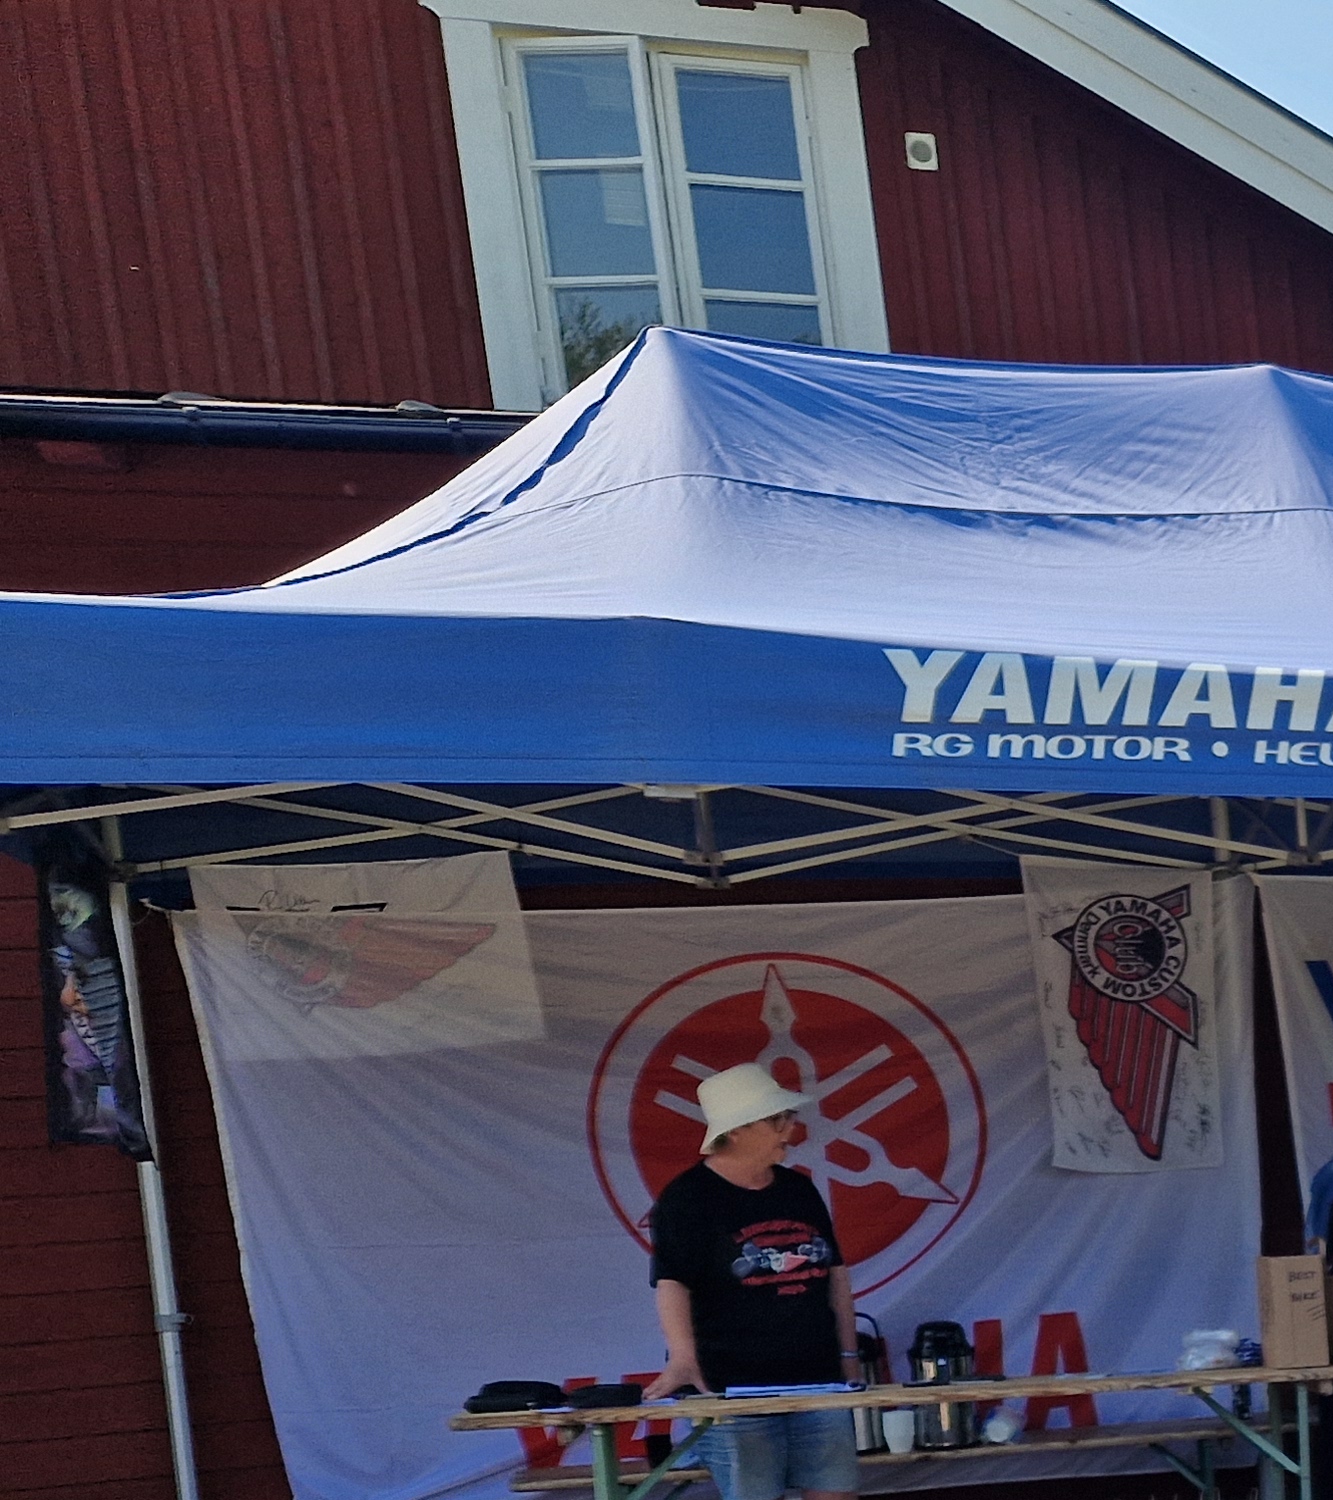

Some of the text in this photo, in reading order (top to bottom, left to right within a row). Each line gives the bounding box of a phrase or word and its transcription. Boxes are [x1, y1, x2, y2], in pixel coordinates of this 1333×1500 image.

[891, 733, 974, 757] RG
[987, 734, 1192, 761] MOTOR
[1077, 911, 1101, 979] Denmark
[1099, 899, 1181, 998] YAMAHA CUSTOM
